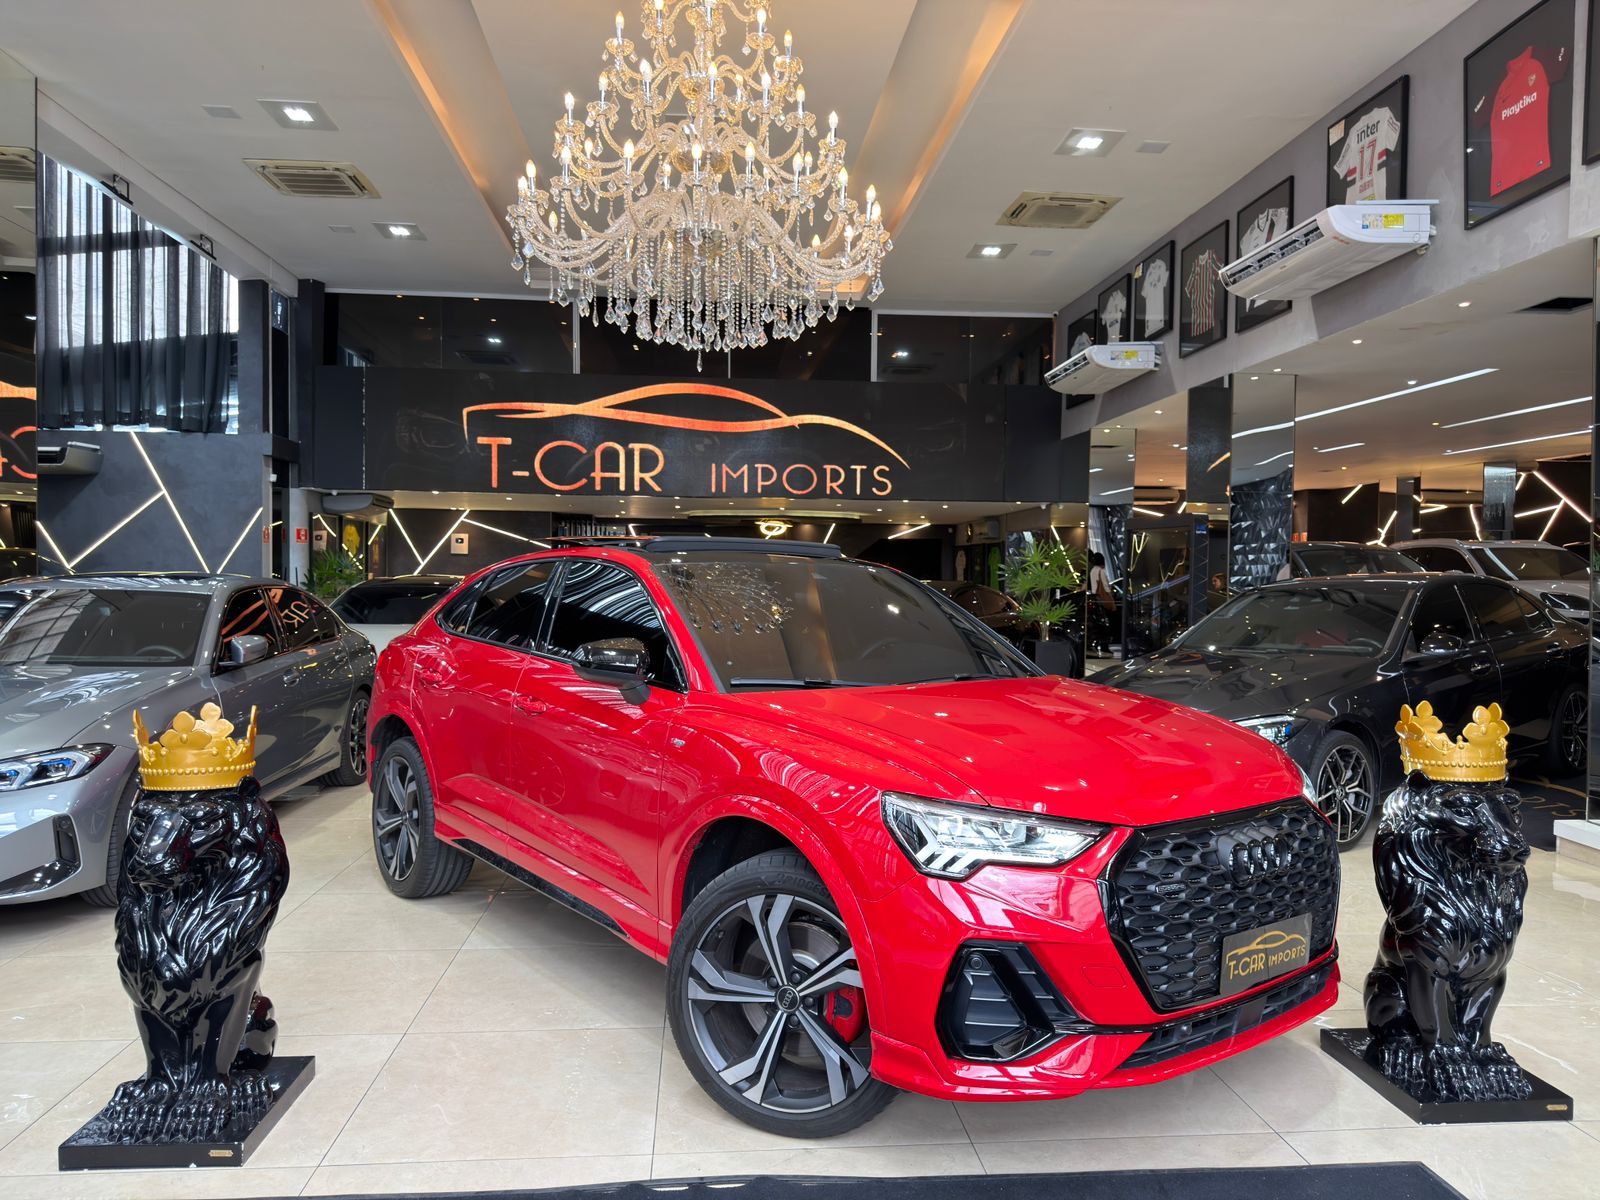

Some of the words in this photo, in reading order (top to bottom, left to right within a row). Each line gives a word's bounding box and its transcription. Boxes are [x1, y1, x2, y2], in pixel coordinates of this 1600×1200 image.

[1502, 92, 1537, 120] Playtika
[1357, 120, 1380, 144] inter
[1359, 138, 1377, 181] 17
[476, 436, 665, 493] T-CAR
[711, 463, 893, 497] IMPORTS
[1228, 952, 1266, 980] T-CAR
[1268, 944, 1306, 967] IMPORTS
